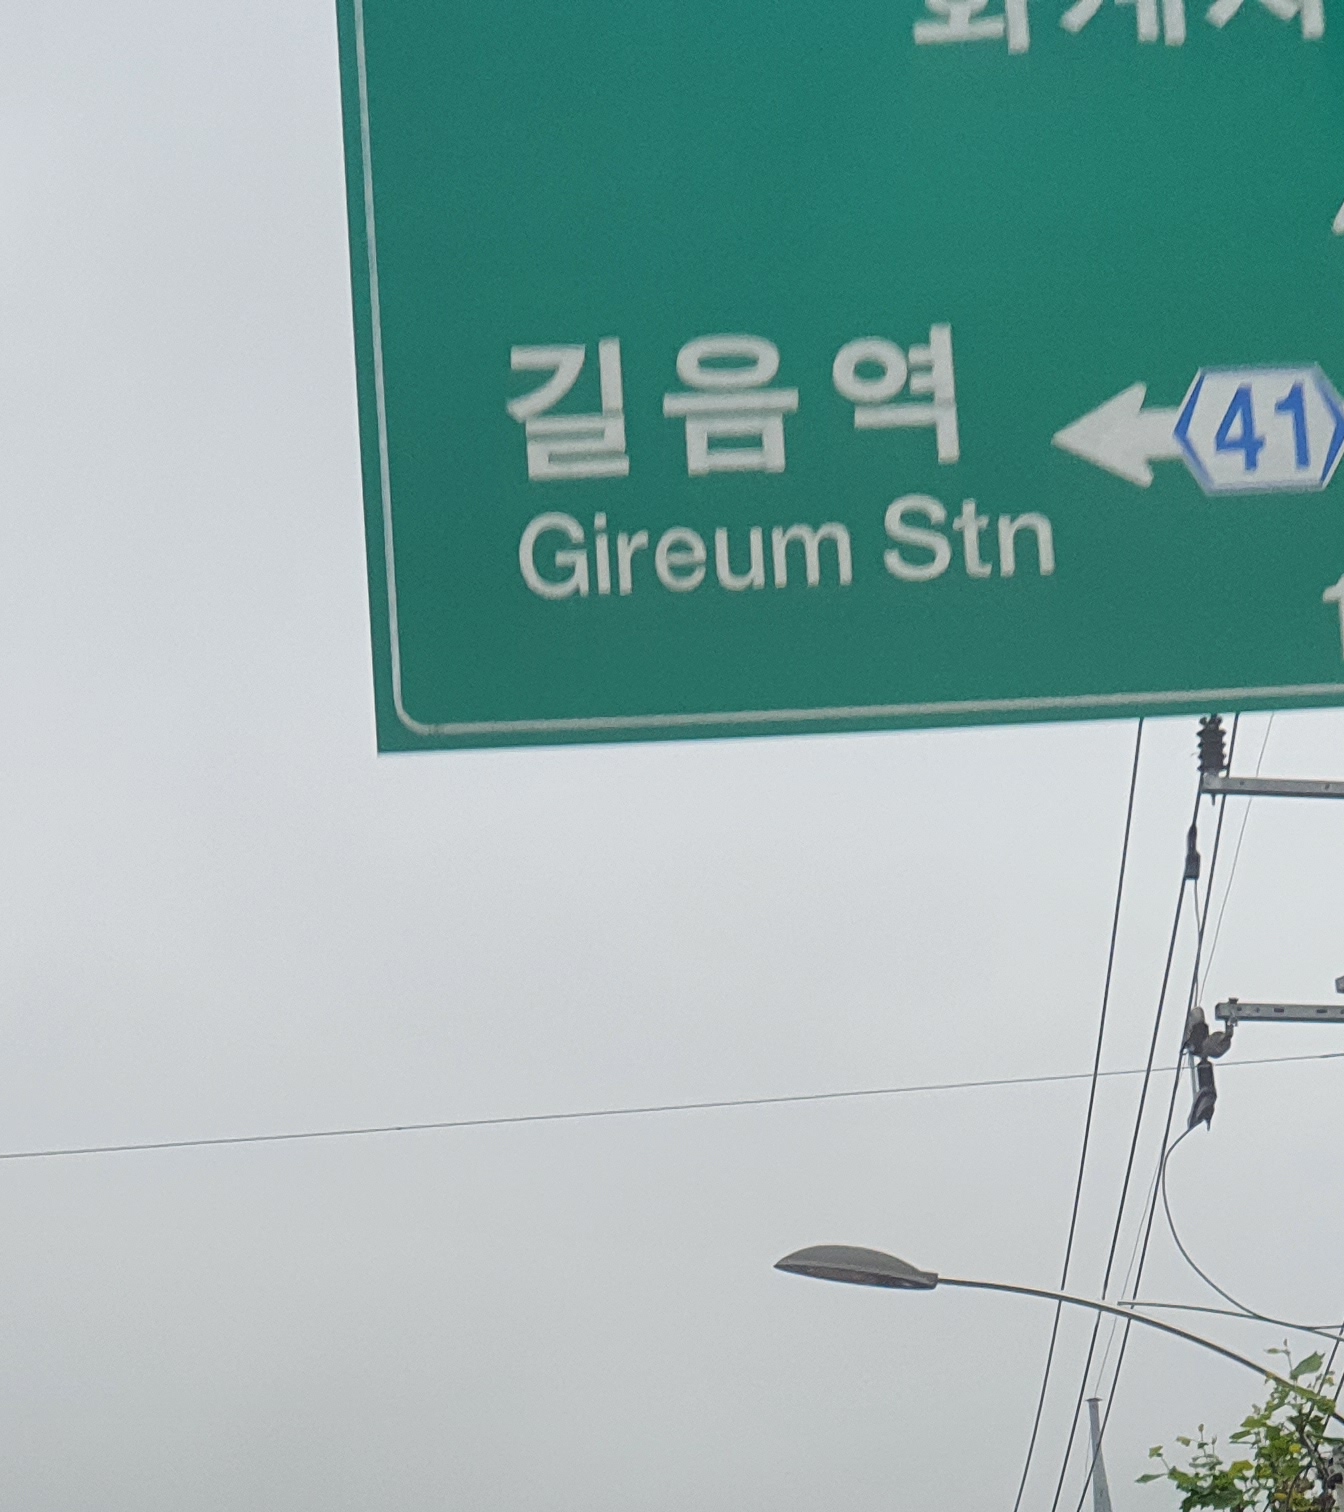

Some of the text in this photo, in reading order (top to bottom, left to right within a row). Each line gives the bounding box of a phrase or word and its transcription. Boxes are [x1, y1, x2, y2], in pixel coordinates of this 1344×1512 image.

[506, 323, 959, 481] 길음역
[1214, 382, 1311, 473] 41
[518, 494, 1054, 598] Gireum Stn
